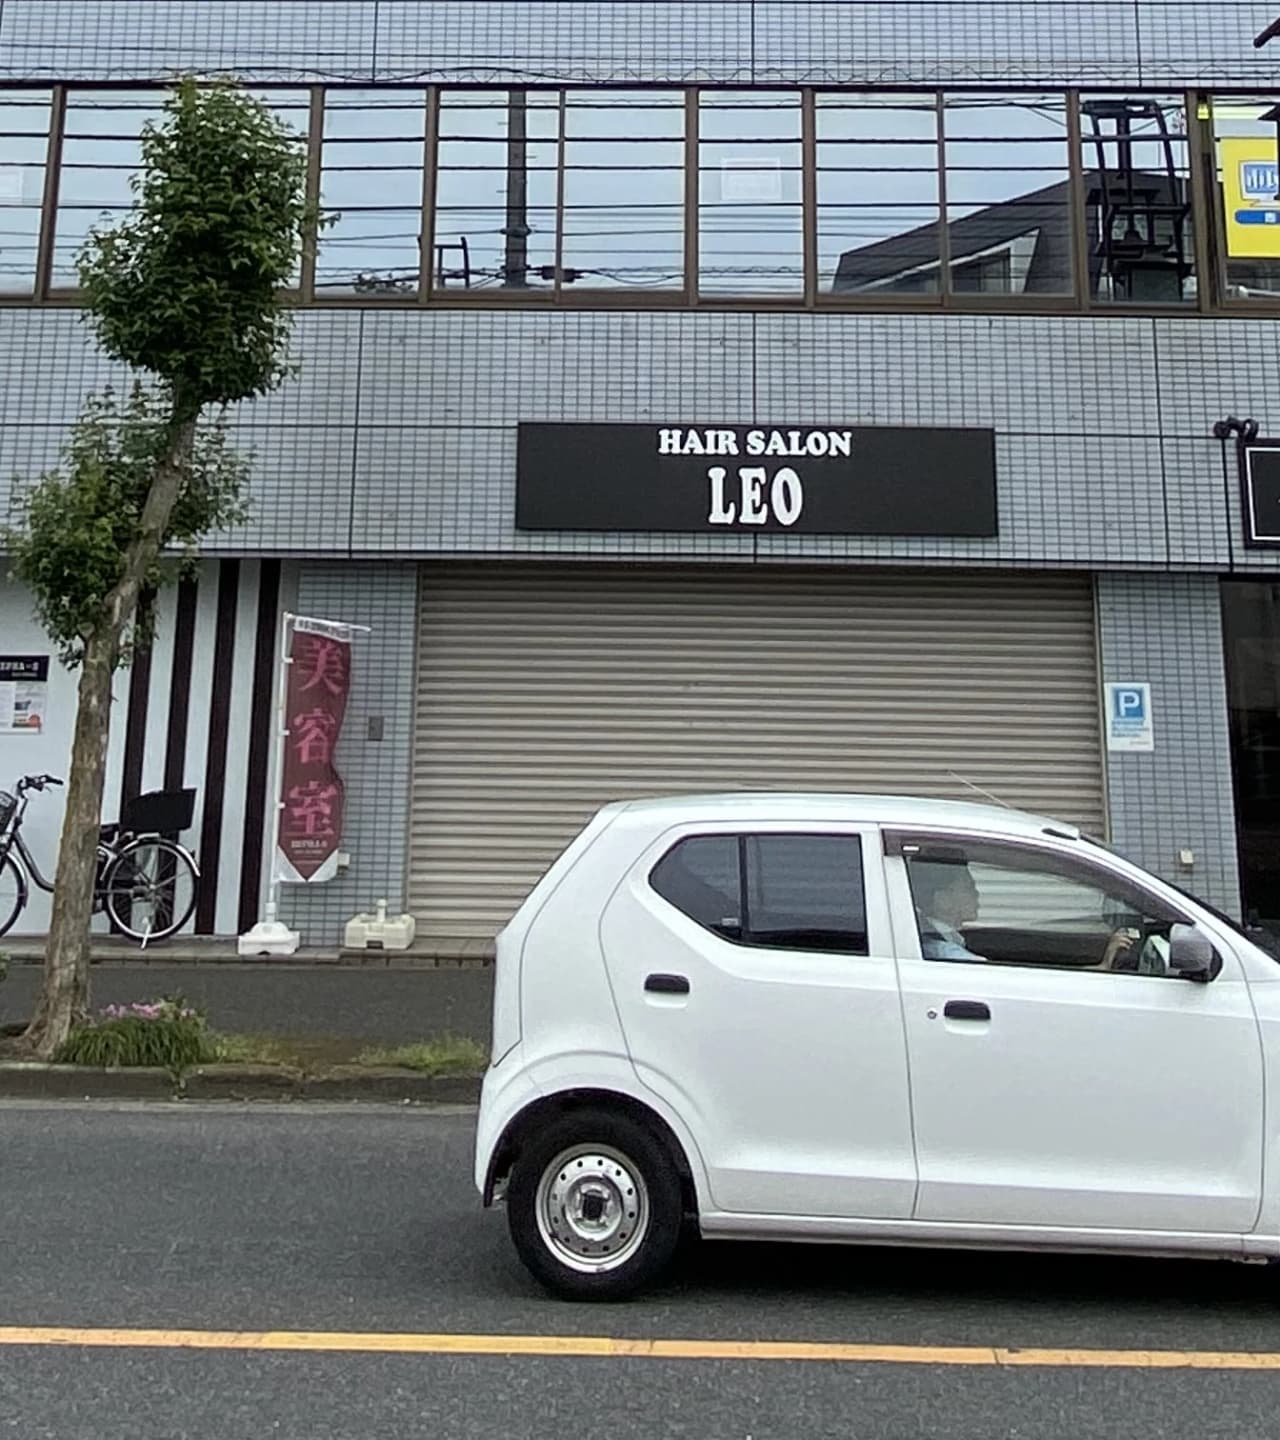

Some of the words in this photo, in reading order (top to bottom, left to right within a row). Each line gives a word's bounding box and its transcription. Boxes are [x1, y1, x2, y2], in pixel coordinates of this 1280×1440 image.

[658, 429, 739, 455] HAIR
[746, 430, 852, 456] SALON
[708, 466, 803, 526] LEO
[1119, 691, 1140, 717] P
[289, 639, 343, 836] 美容室
